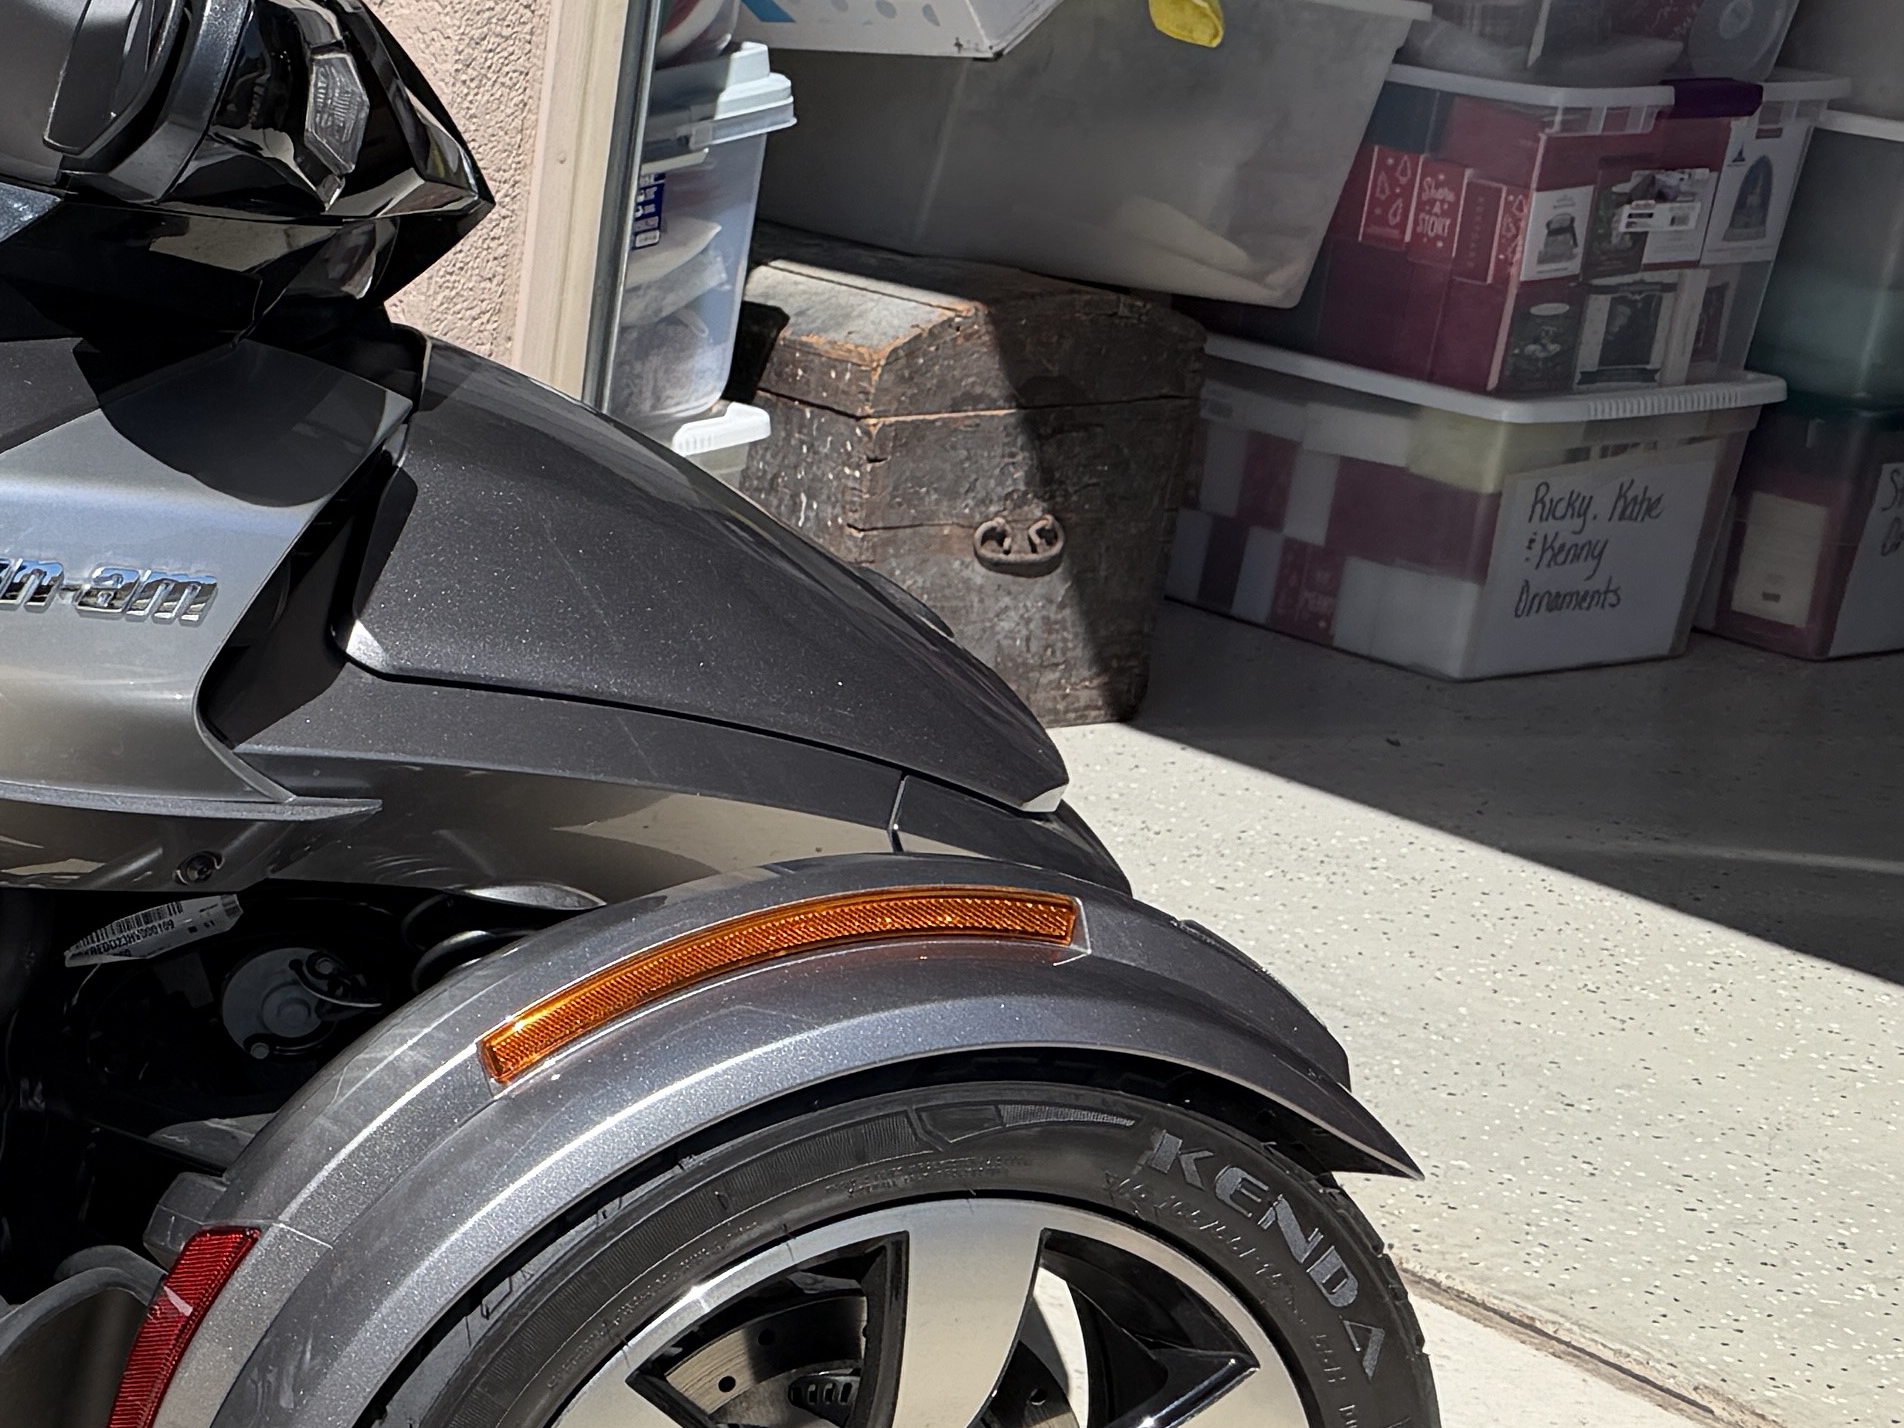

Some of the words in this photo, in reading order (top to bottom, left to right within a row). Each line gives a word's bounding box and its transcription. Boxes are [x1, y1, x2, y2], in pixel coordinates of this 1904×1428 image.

[1535, 530, 1609, 582] Kenny
[1514, 575, 1622, 619] Ornaments
[1146, 1128, 1386, 1381] KENDA
